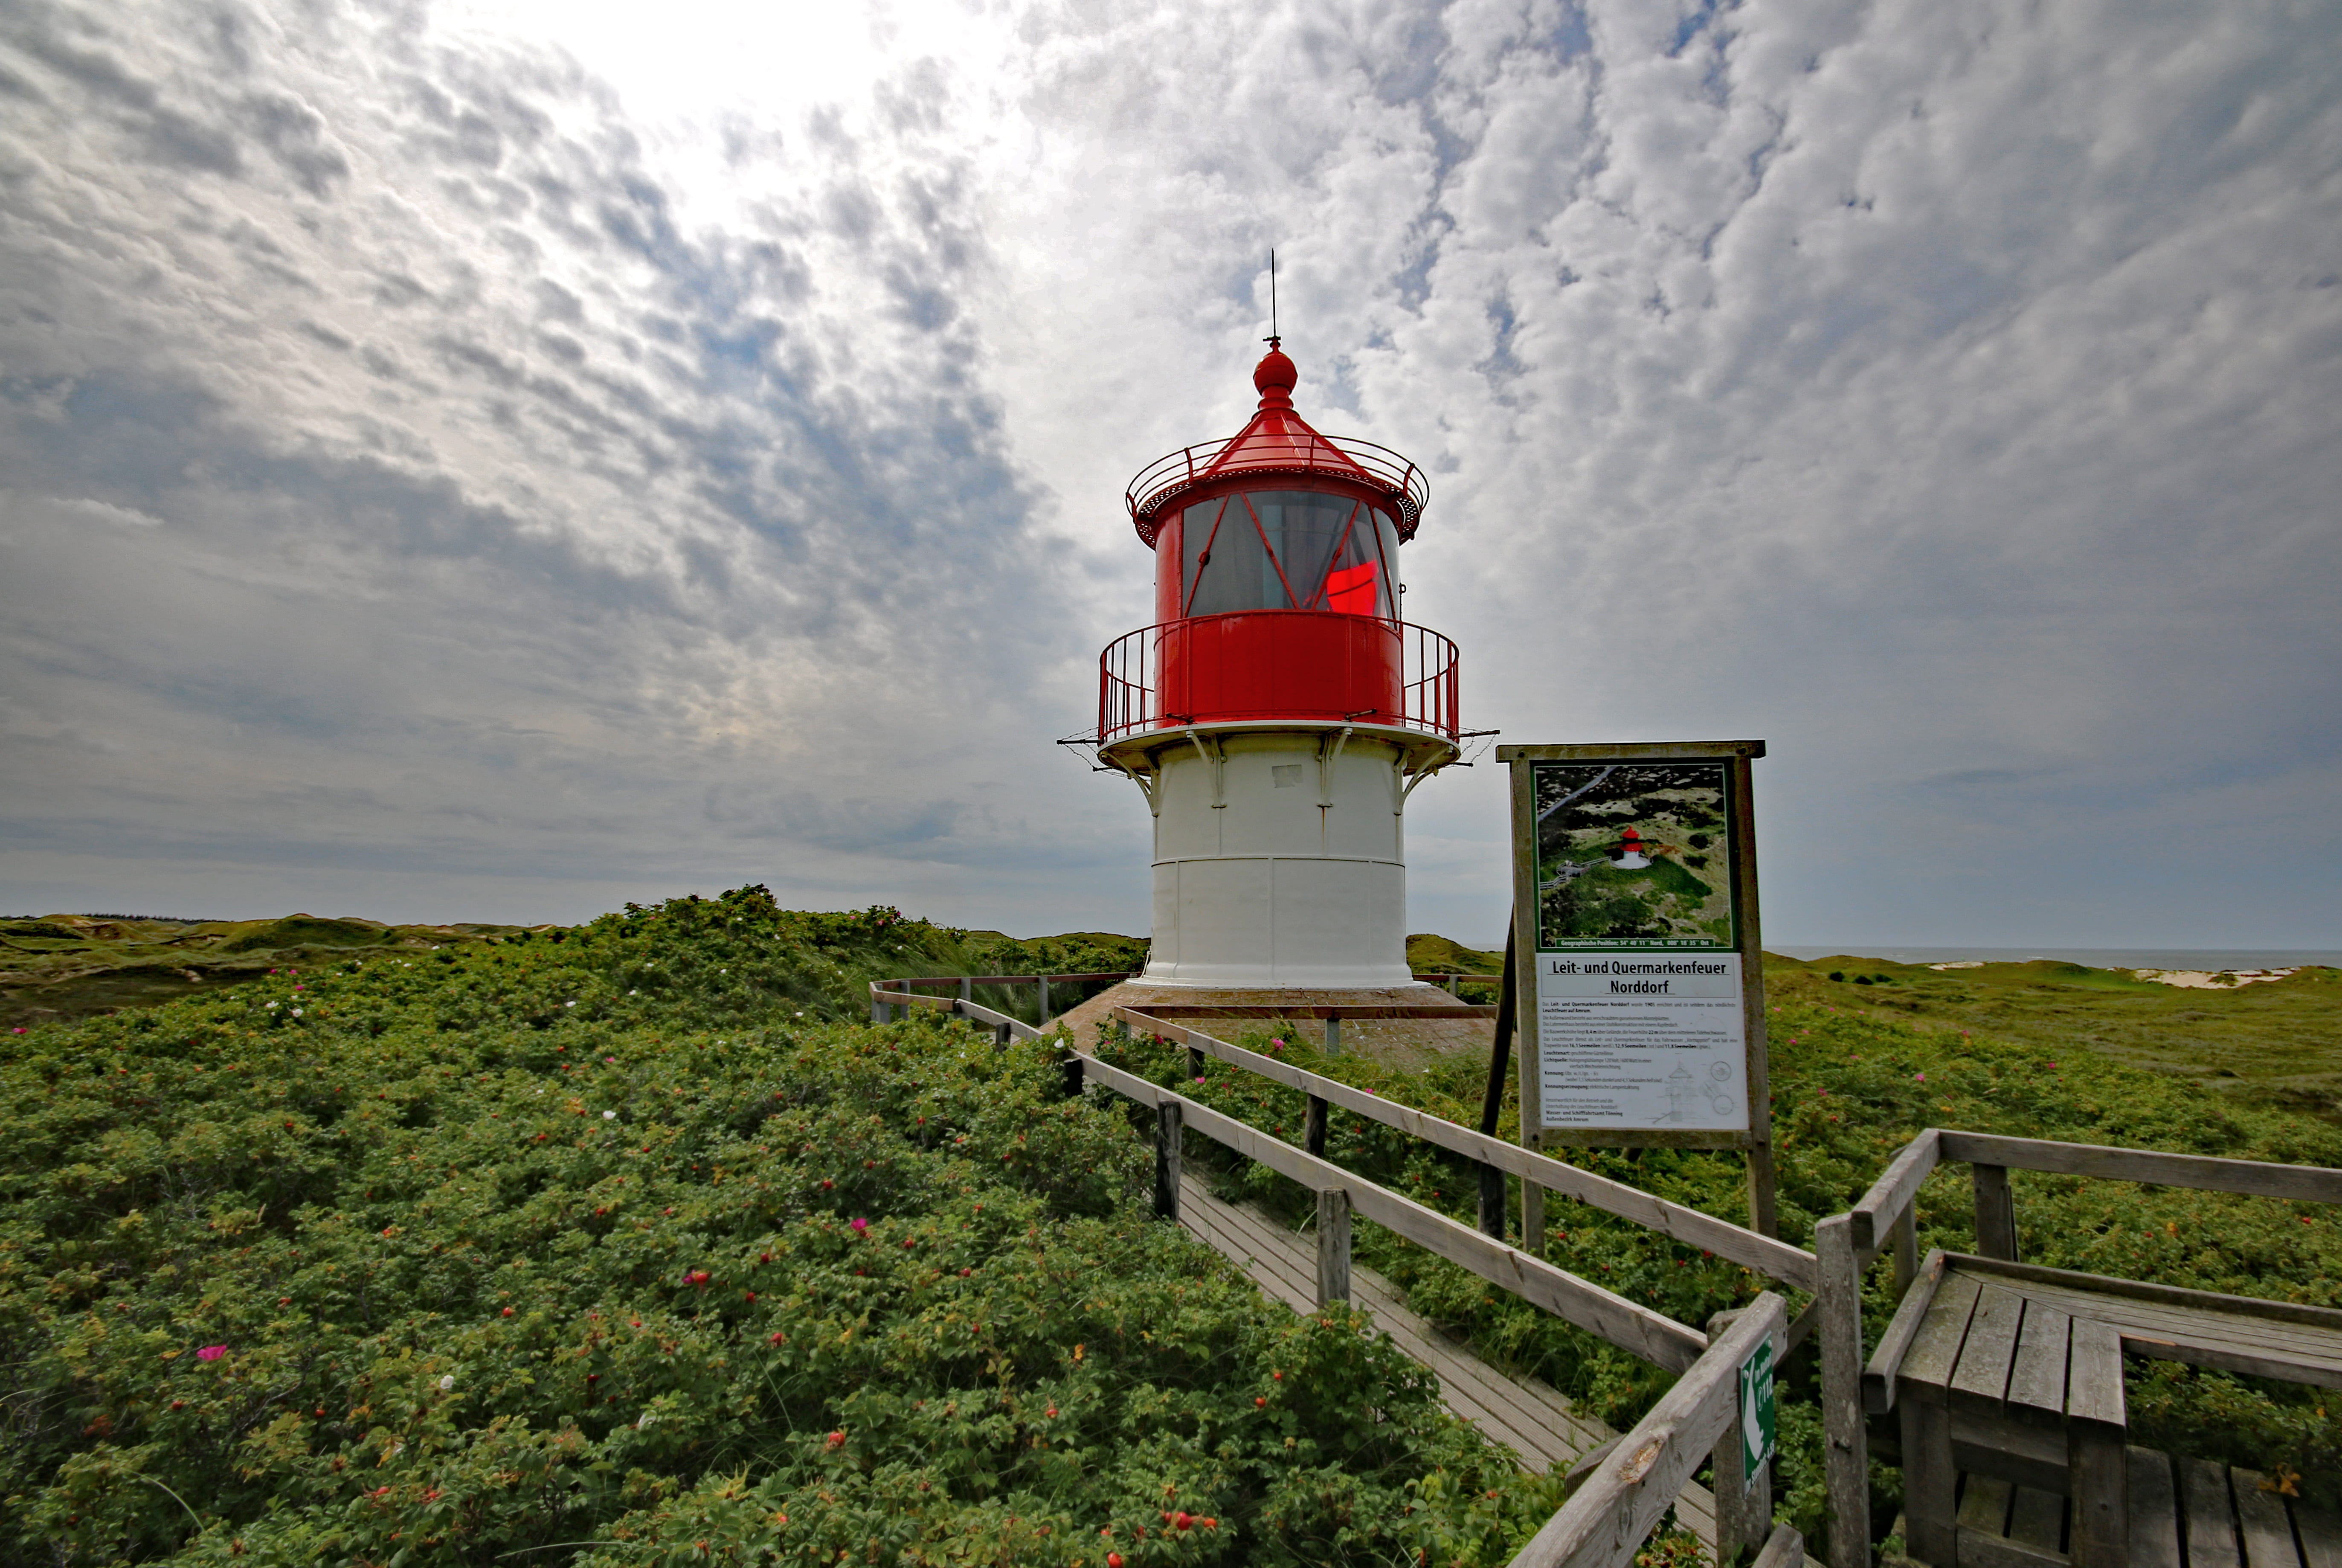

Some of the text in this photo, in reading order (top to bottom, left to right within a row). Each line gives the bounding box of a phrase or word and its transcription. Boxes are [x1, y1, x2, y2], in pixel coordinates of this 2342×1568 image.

[1553, 960, 1726, 975] Leit- und Quermarkenfeuer
[1611, 980, 1669, 993] Norddorf
[1763, 1373, 1773, 1402] 112
